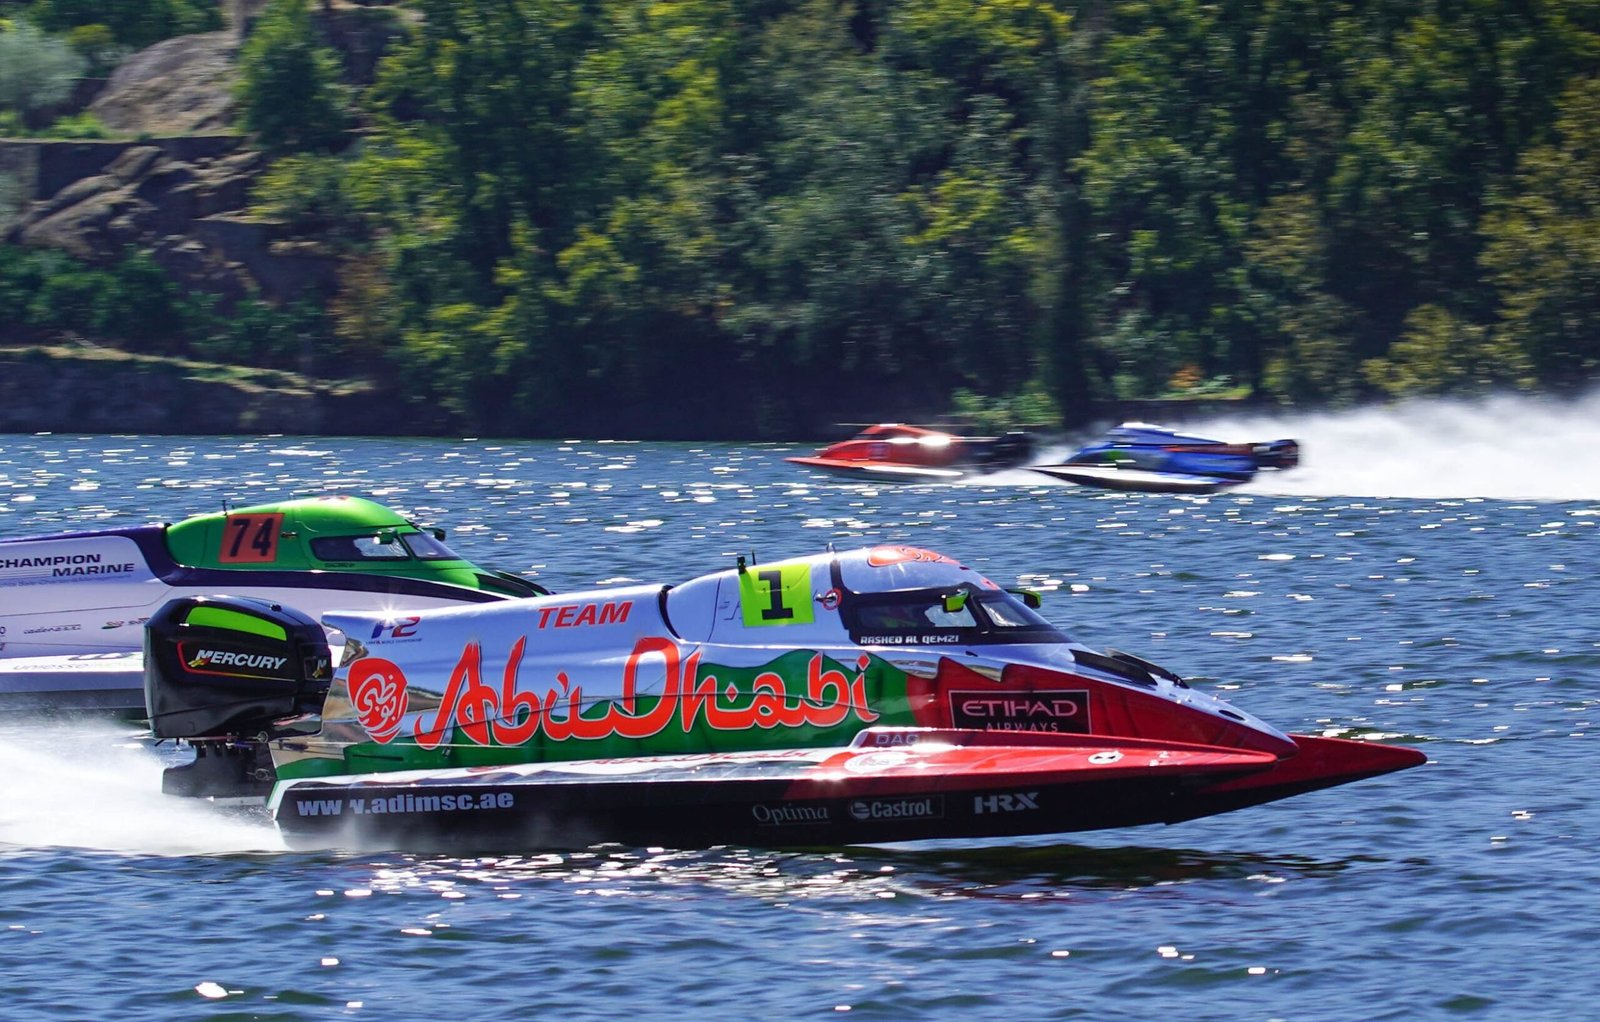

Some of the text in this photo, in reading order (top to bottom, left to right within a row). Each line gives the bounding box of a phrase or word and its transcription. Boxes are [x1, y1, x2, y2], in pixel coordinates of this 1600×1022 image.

[229, 517, 275, 557] 74
[52, 564, 135, 577] MARINE
[758, 570, 793, 620] 1
[538, 602, 632, 629] TEAM
[860, 634, 960, 645] RASHED AL QEMZI
[194, 649, 287, 670] MERCURY
[413, 634, 880, 750] Abu Dhabi
[962, 700, 1078, 717] ETIHAD
[871, 800, 934, 818] Castrol
[974, 792, 1040, 814] HRX
[752, 803, 829, 826] Optima
